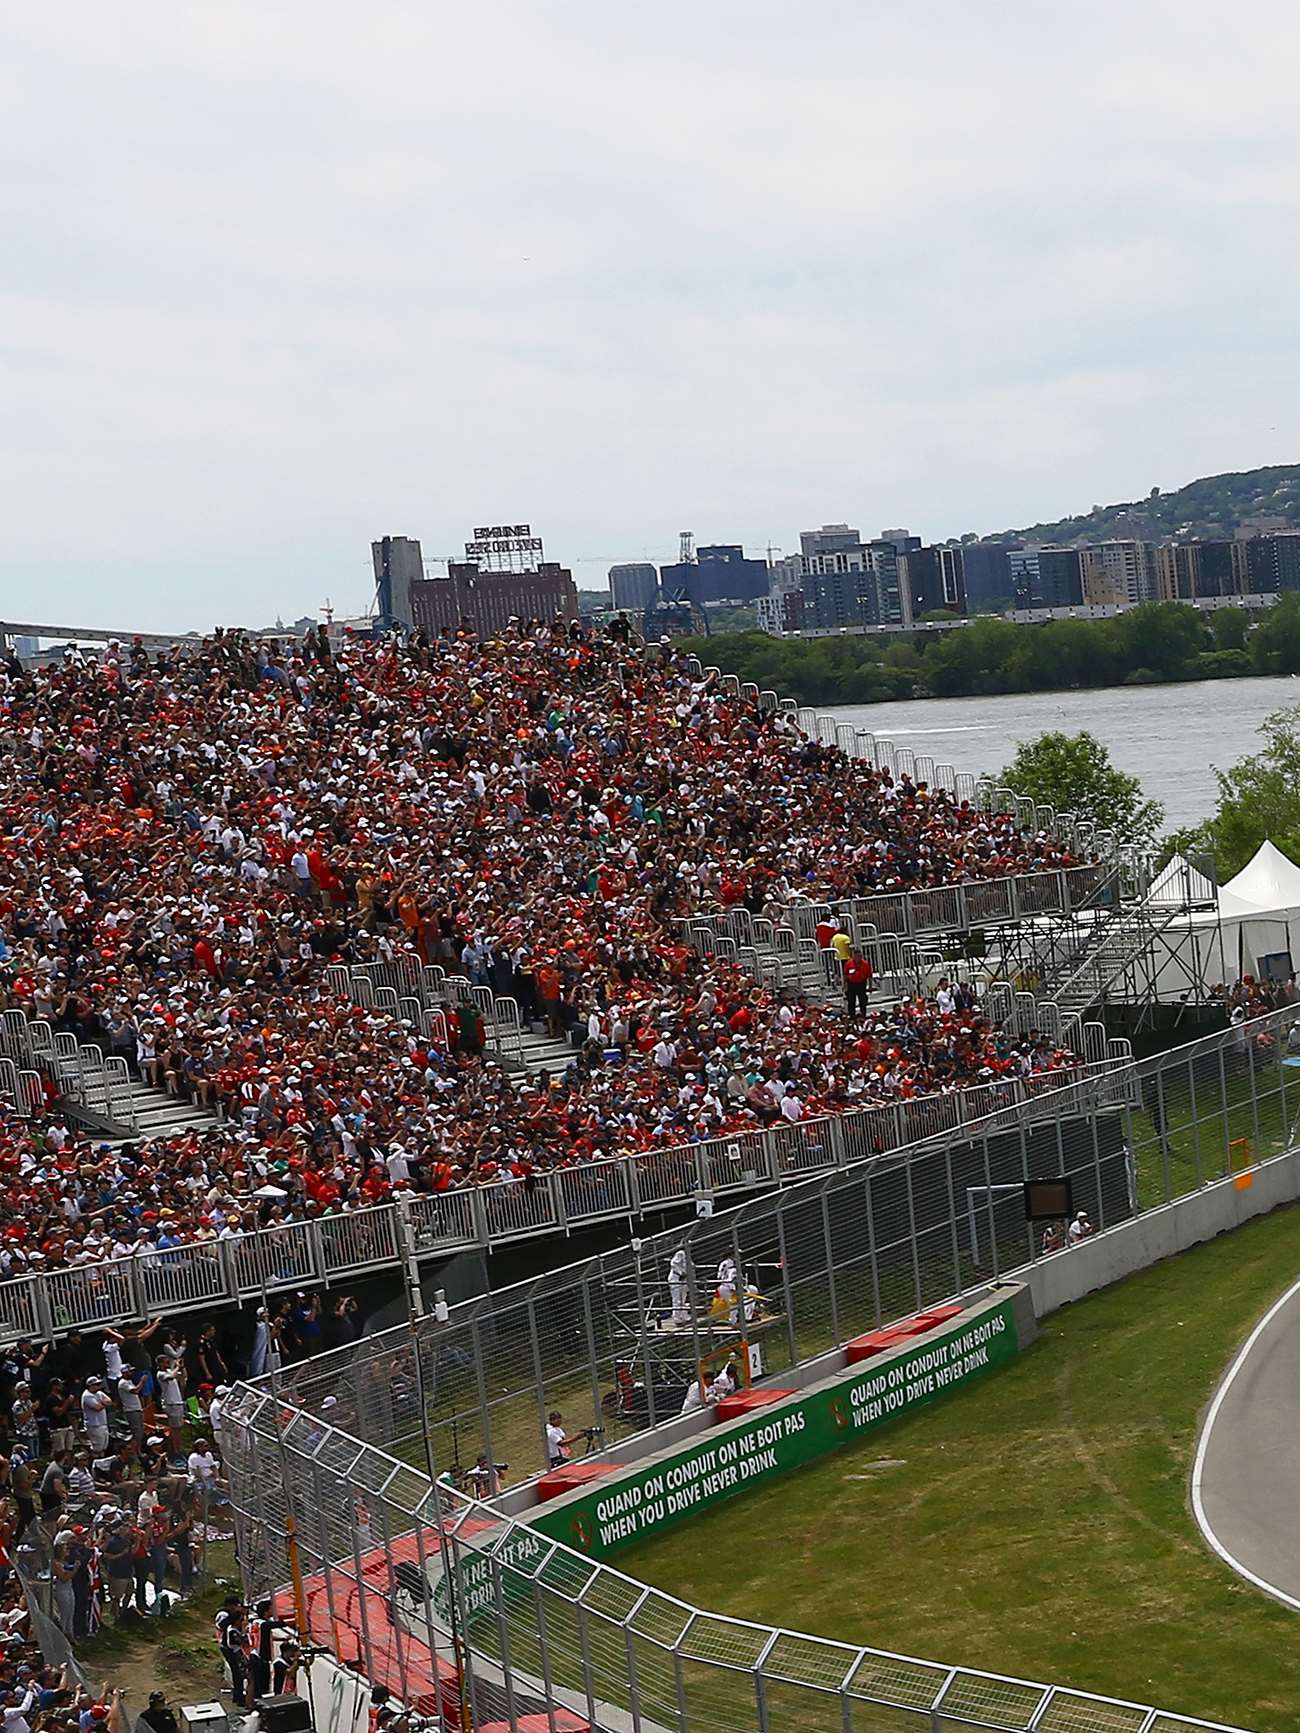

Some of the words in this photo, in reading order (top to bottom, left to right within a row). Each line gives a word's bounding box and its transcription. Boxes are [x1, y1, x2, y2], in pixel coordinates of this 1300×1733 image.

[752, 1353, 758, 1368] 2
[850, 1376, 887, 1406] QUAND
[888, 1366, 905, 1388] ON
[906, 1346, 948, 1379] CONDUIT
[951, 1338, 963, 1360] ON
[963, 1331, 974, 1352] NE
[974, 1321, 991, 1346] BOIT
[991, 1315, 1006, 1338] PAS
[852, 1400, 882, 1427] WHEN
[883, 1389, 904, 1413] YOU
[907, 1375, 934, 1402] DRIVE
[935, 1361, 963, 1388] NEVER
[964, 1347, 989, 1374] DRINK
[597, 1487, 641, 1522] QUAND
[644, 1475, 664, 1499] ON
[666, 1450, 717, 1490] CONDUIT
[718, 1440, 738, 1464] ON
[739, 1432, 756, 1456] NE
[757, 1419, 784, 1447] BOIT
[784, 1411, 805, 1436] PAS
[599, 1514, 637, 1546] WHEN
[638, 1501, 665, 1528] YOU
[668, 1483, 701, 1515] DRIVE
[703, 1469, 738, 1498] NEVER
[740, 1448, 778, 1480] DRINK
[517, 1535, 539, 1561] PAS
